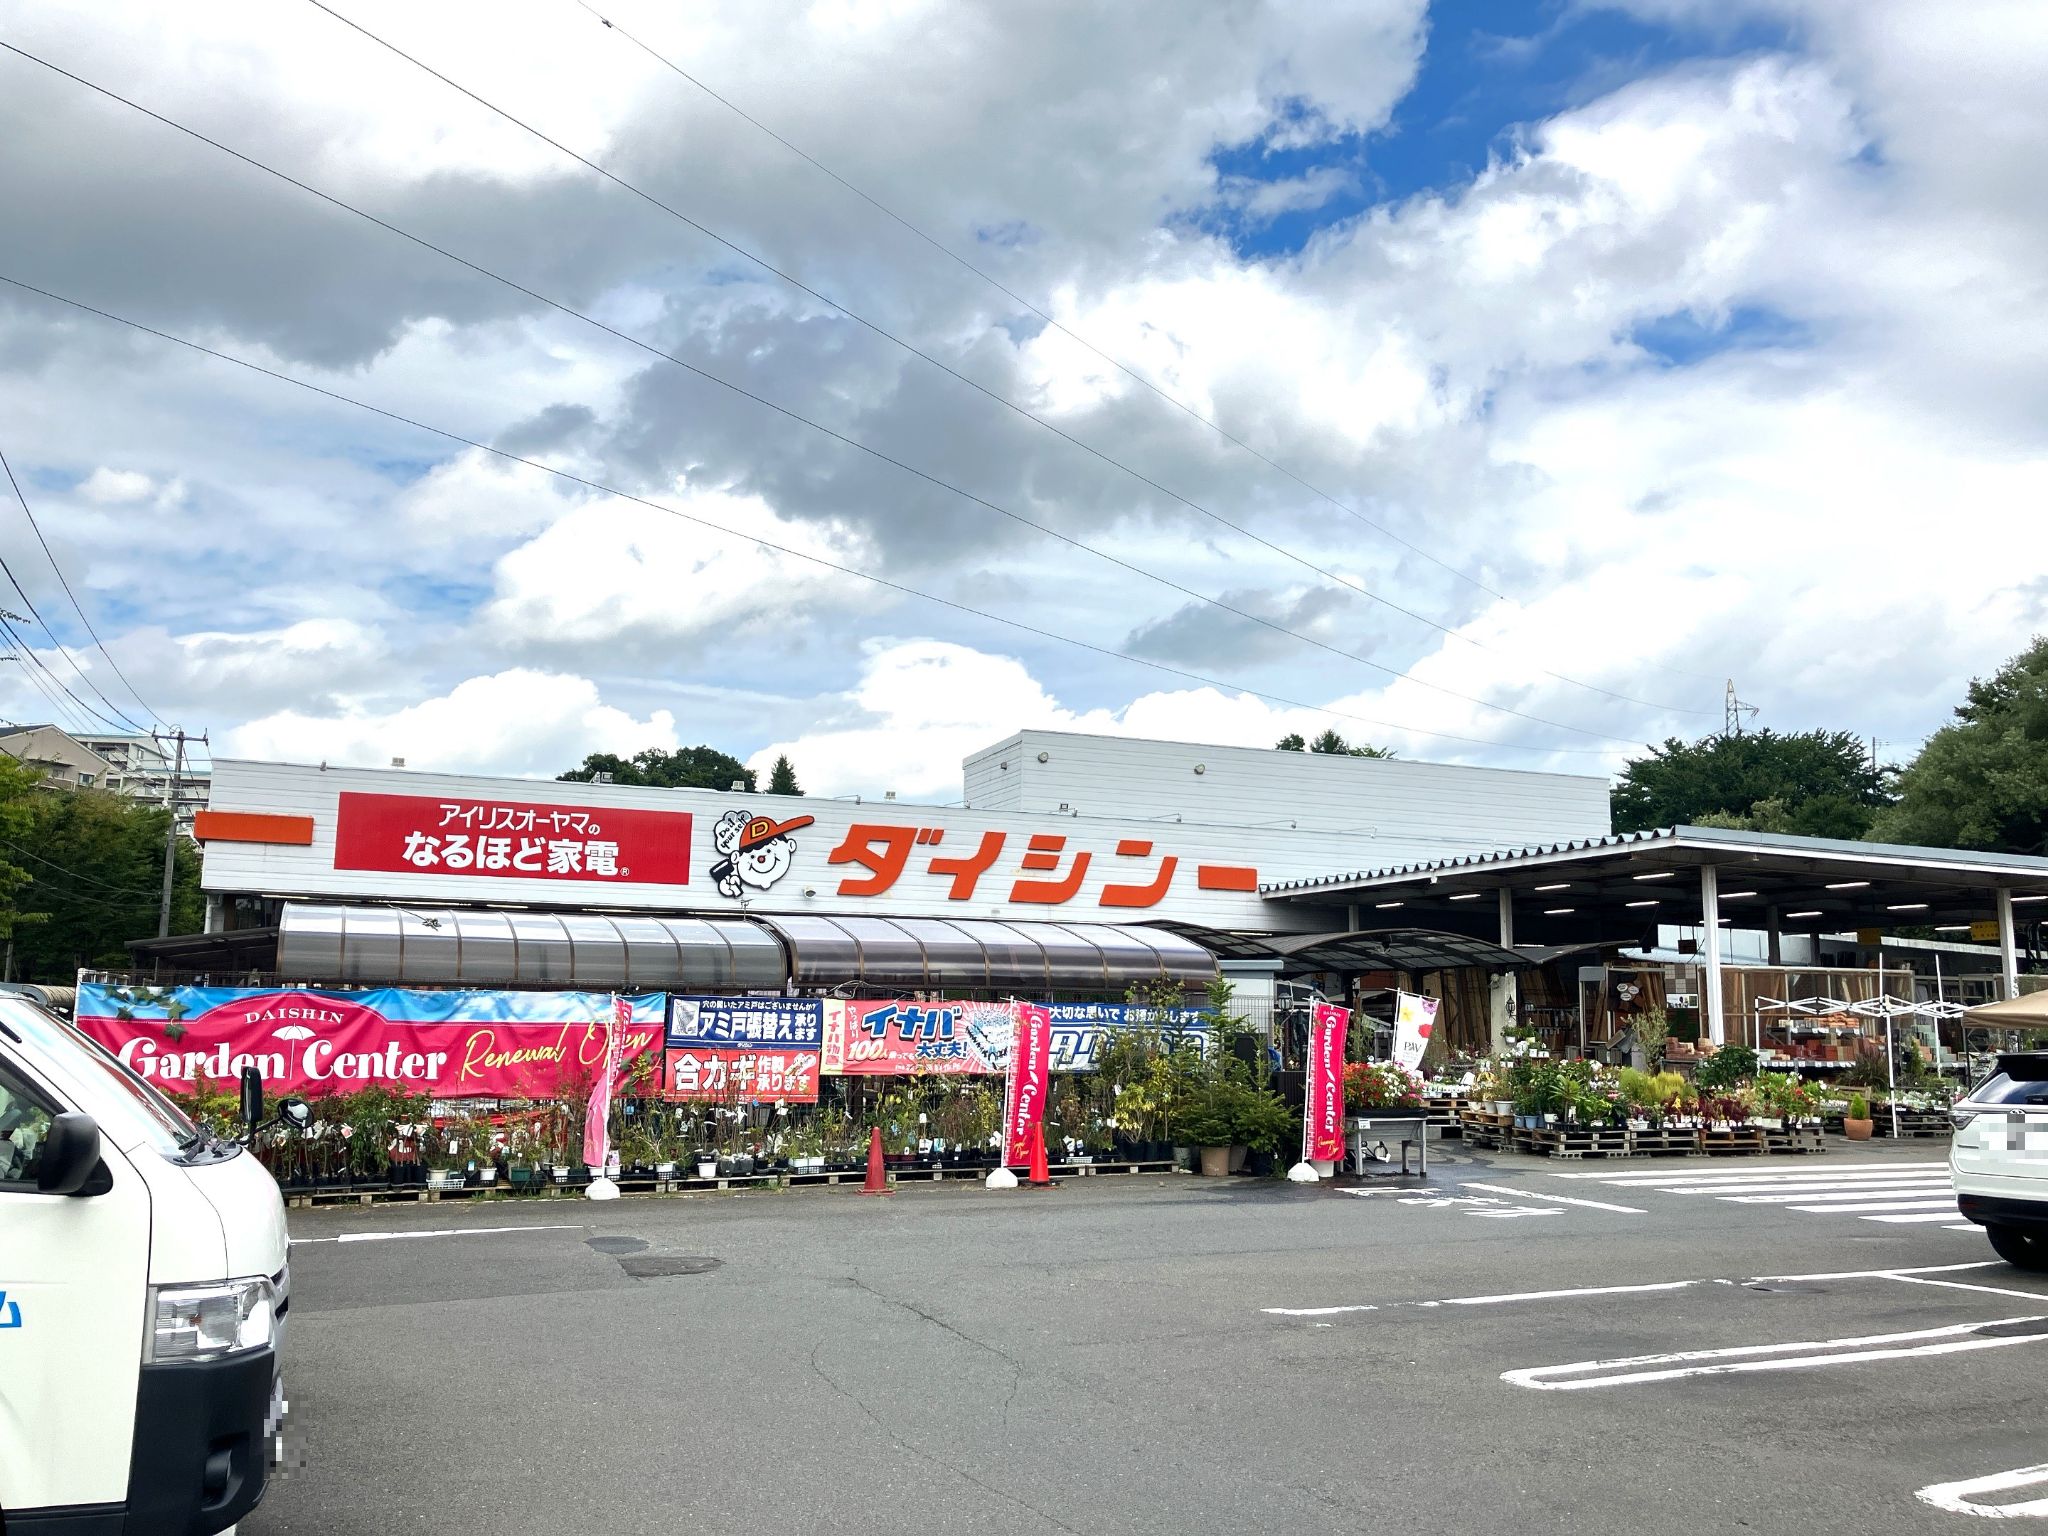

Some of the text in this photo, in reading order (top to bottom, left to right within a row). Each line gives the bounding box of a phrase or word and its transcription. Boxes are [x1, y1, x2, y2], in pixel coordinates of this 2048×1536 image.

[438, 803, 601, 836] アイリスオーヤマの
[719, 827, 730, 839] Do
[751, 821, 769, 839] D
[720, 832, 736, 850] your
[244, 1007, 345, 1025] DAISHIN
[698, 1011, 793, 1040] アミ戸張替え
[794, 1012, 817, 1028] 承り
[847, 1005, 860, 1039] やっぱり
[861, 1003, 963, 1042] イナバ
[1050, 1006, 1120, 1021] 大切な思いで
[794, 1028, 817, 1041] ます
[1028, 1015, 1043, 1071] Garden
[118, 1036, 286, 1081] Garden
[302, 1039, 448, 1081] Center
[460, 1021, 571, 1082] Renewal
[673, 1052, 757, 1092] 合カギ
[756, 1073, 811, 1092] 承ります
[1323, 1015, 1337, 1133] Garden Center
[1016, 1083, 1038, 1136] Center
